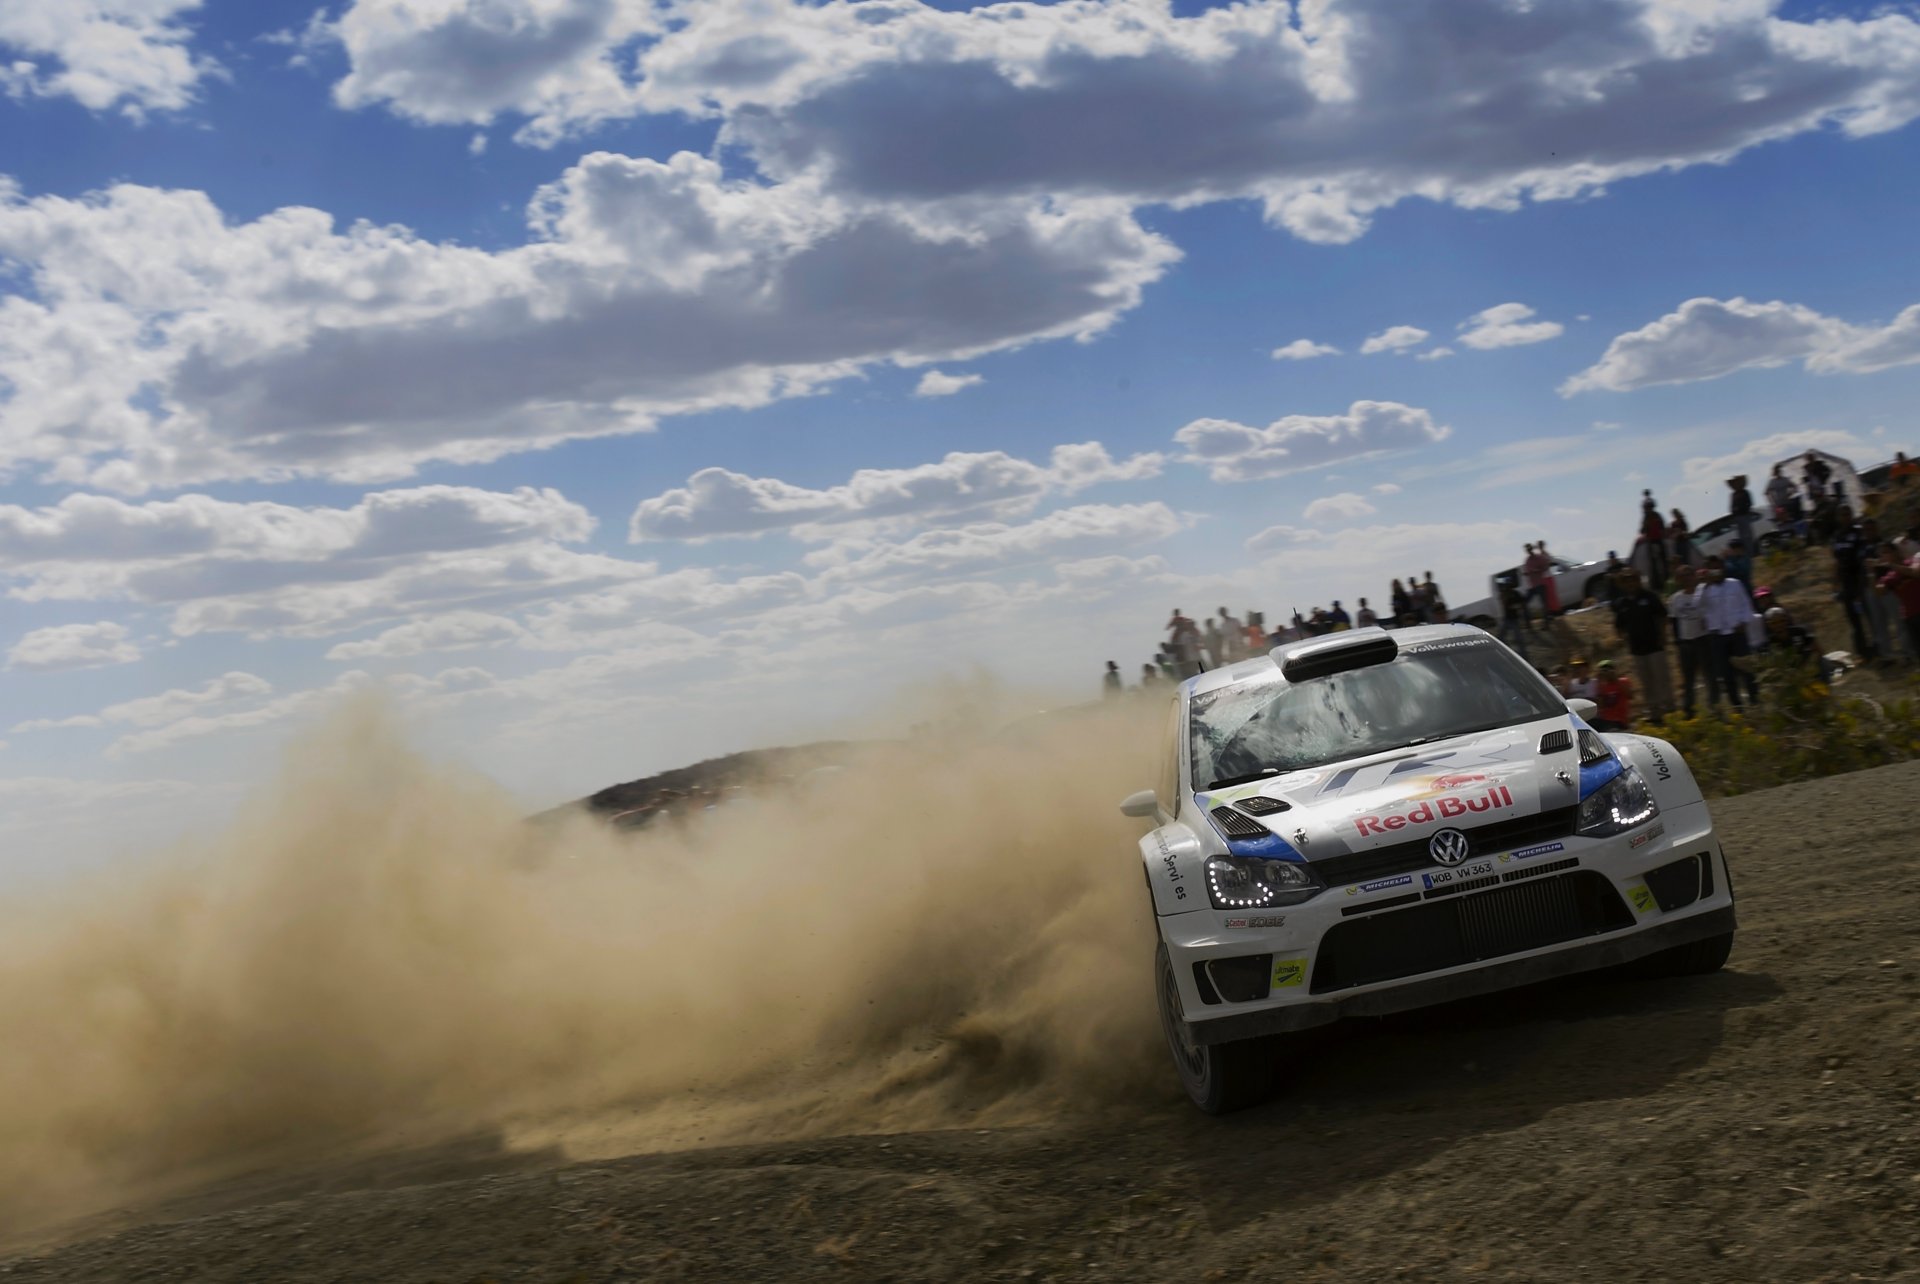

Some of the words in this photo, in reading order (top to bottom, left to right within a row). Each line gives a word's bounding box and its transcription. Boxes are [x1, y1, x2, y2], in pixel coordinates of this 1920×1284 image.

[1408, 639, 1489, 654] Volkswagen
[1354, 802, 1436, 837] Red
[1436, 785, 1514, 818] Bull
[1518, 844, 1561, 857] MICHELIN
[1431, 872, 1452, 884] WOB
[1456, 867, 1471, 878] VW
[1471, 863, 1492, 875] 363
[1366, 876, 1410, 890] MICHELIN
[1248, 915, 1286, 929] EDGE
